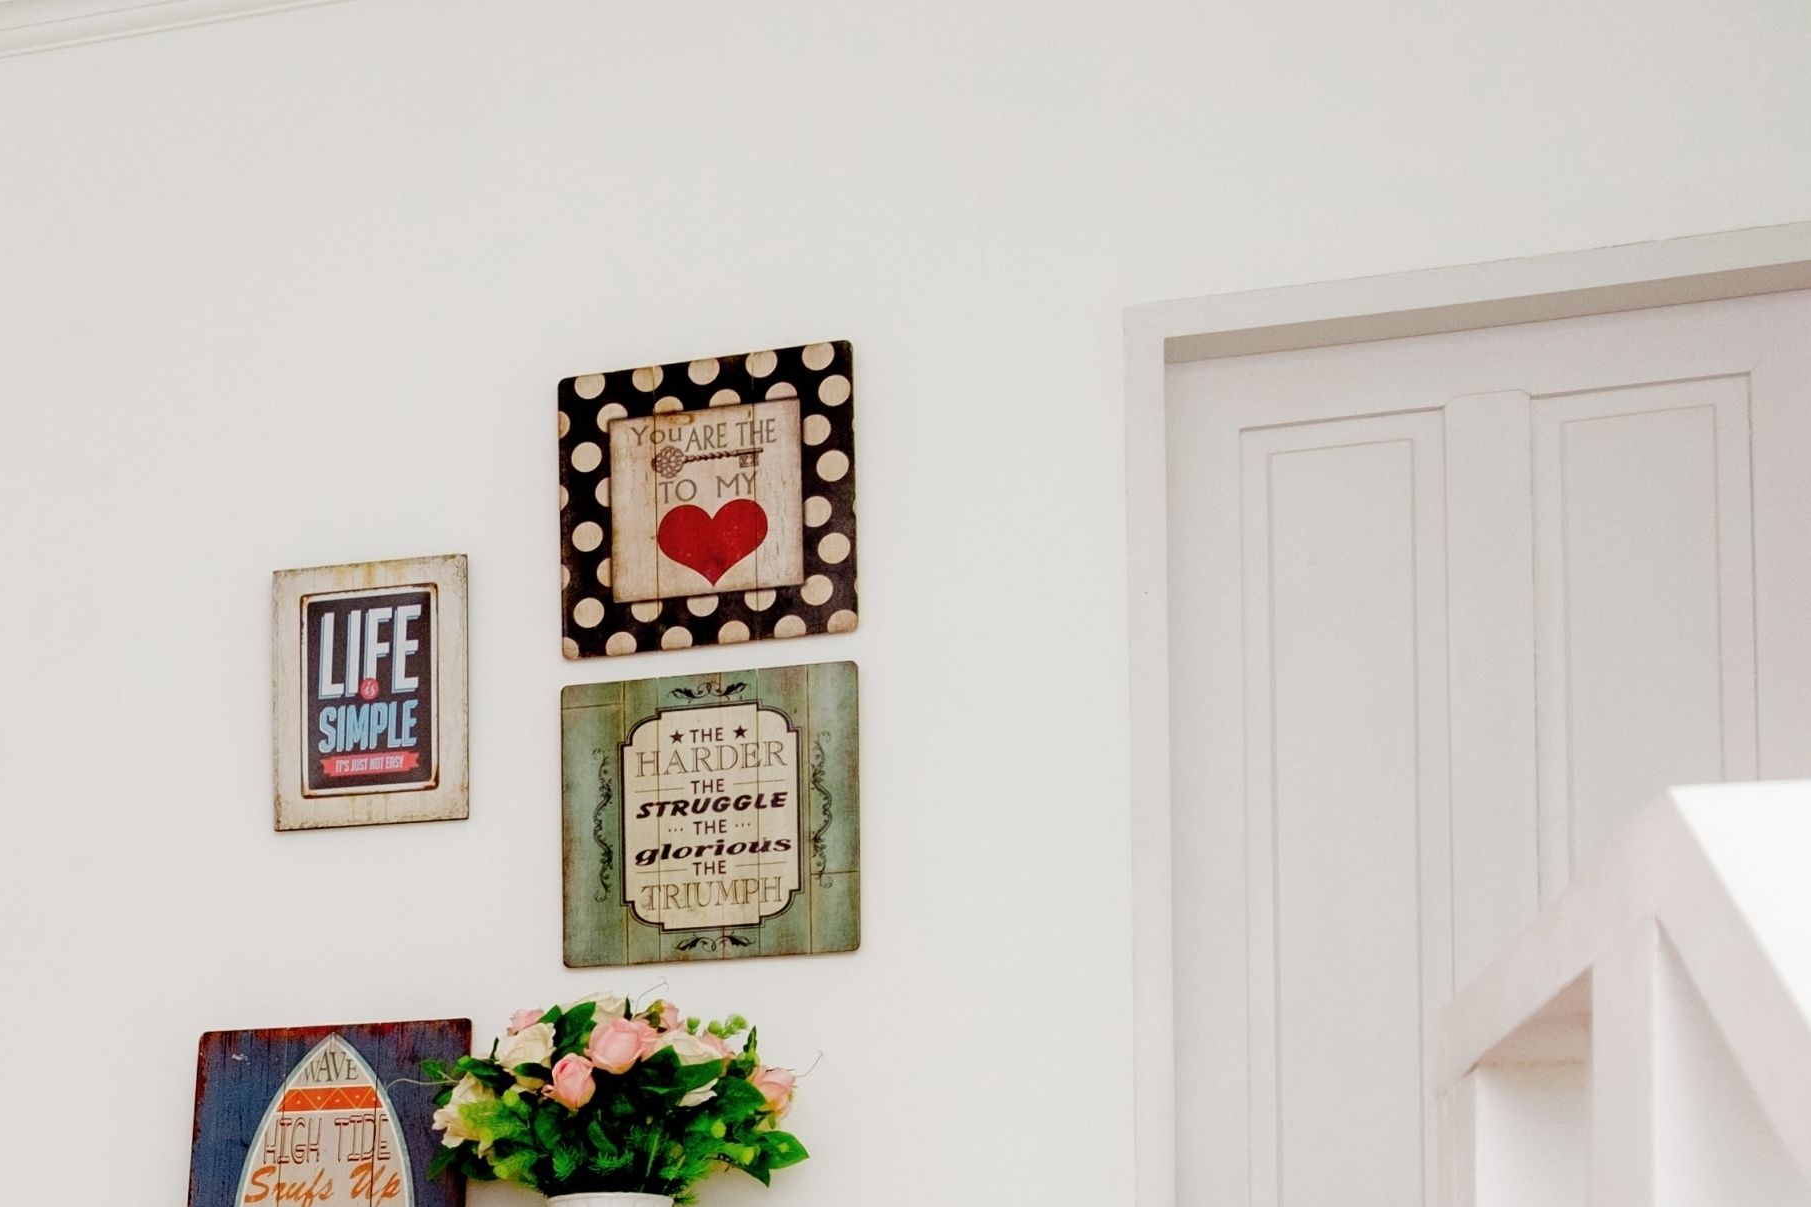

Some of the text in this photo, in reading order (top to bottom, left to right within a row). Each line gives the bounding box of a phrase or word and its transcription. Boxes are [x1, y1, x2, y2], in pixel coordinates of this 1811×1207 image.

[685, 422, 728, 452] ARE
[735, 418, 777, 447] THE
[658, 471, 758, 504] TO MY
[318, 604, 422, 699] LIFE
[318, 699, 419, 753] SIMPLE
[689, 727, 724, 743] THE
[351, 758, 368, 772] JUST
[370, 757, 384, 770] NOT
[386, 755, 404, 769] EASY
[635, 740, 788, 777] HARDER
[690, 778, 725, 795] THE
[636, 792, 788, 819] STRUGGLE
[693, 819, 727, 835] THE
[634, 838, 792, 867] glorious
[692, 860, 727, 876] THE
[640, 876, 782, 911] TRIUMPH
[299, 1050, 360, 1083] WAVE
[263, 1114, 391, 1165] HIGH TIDE
